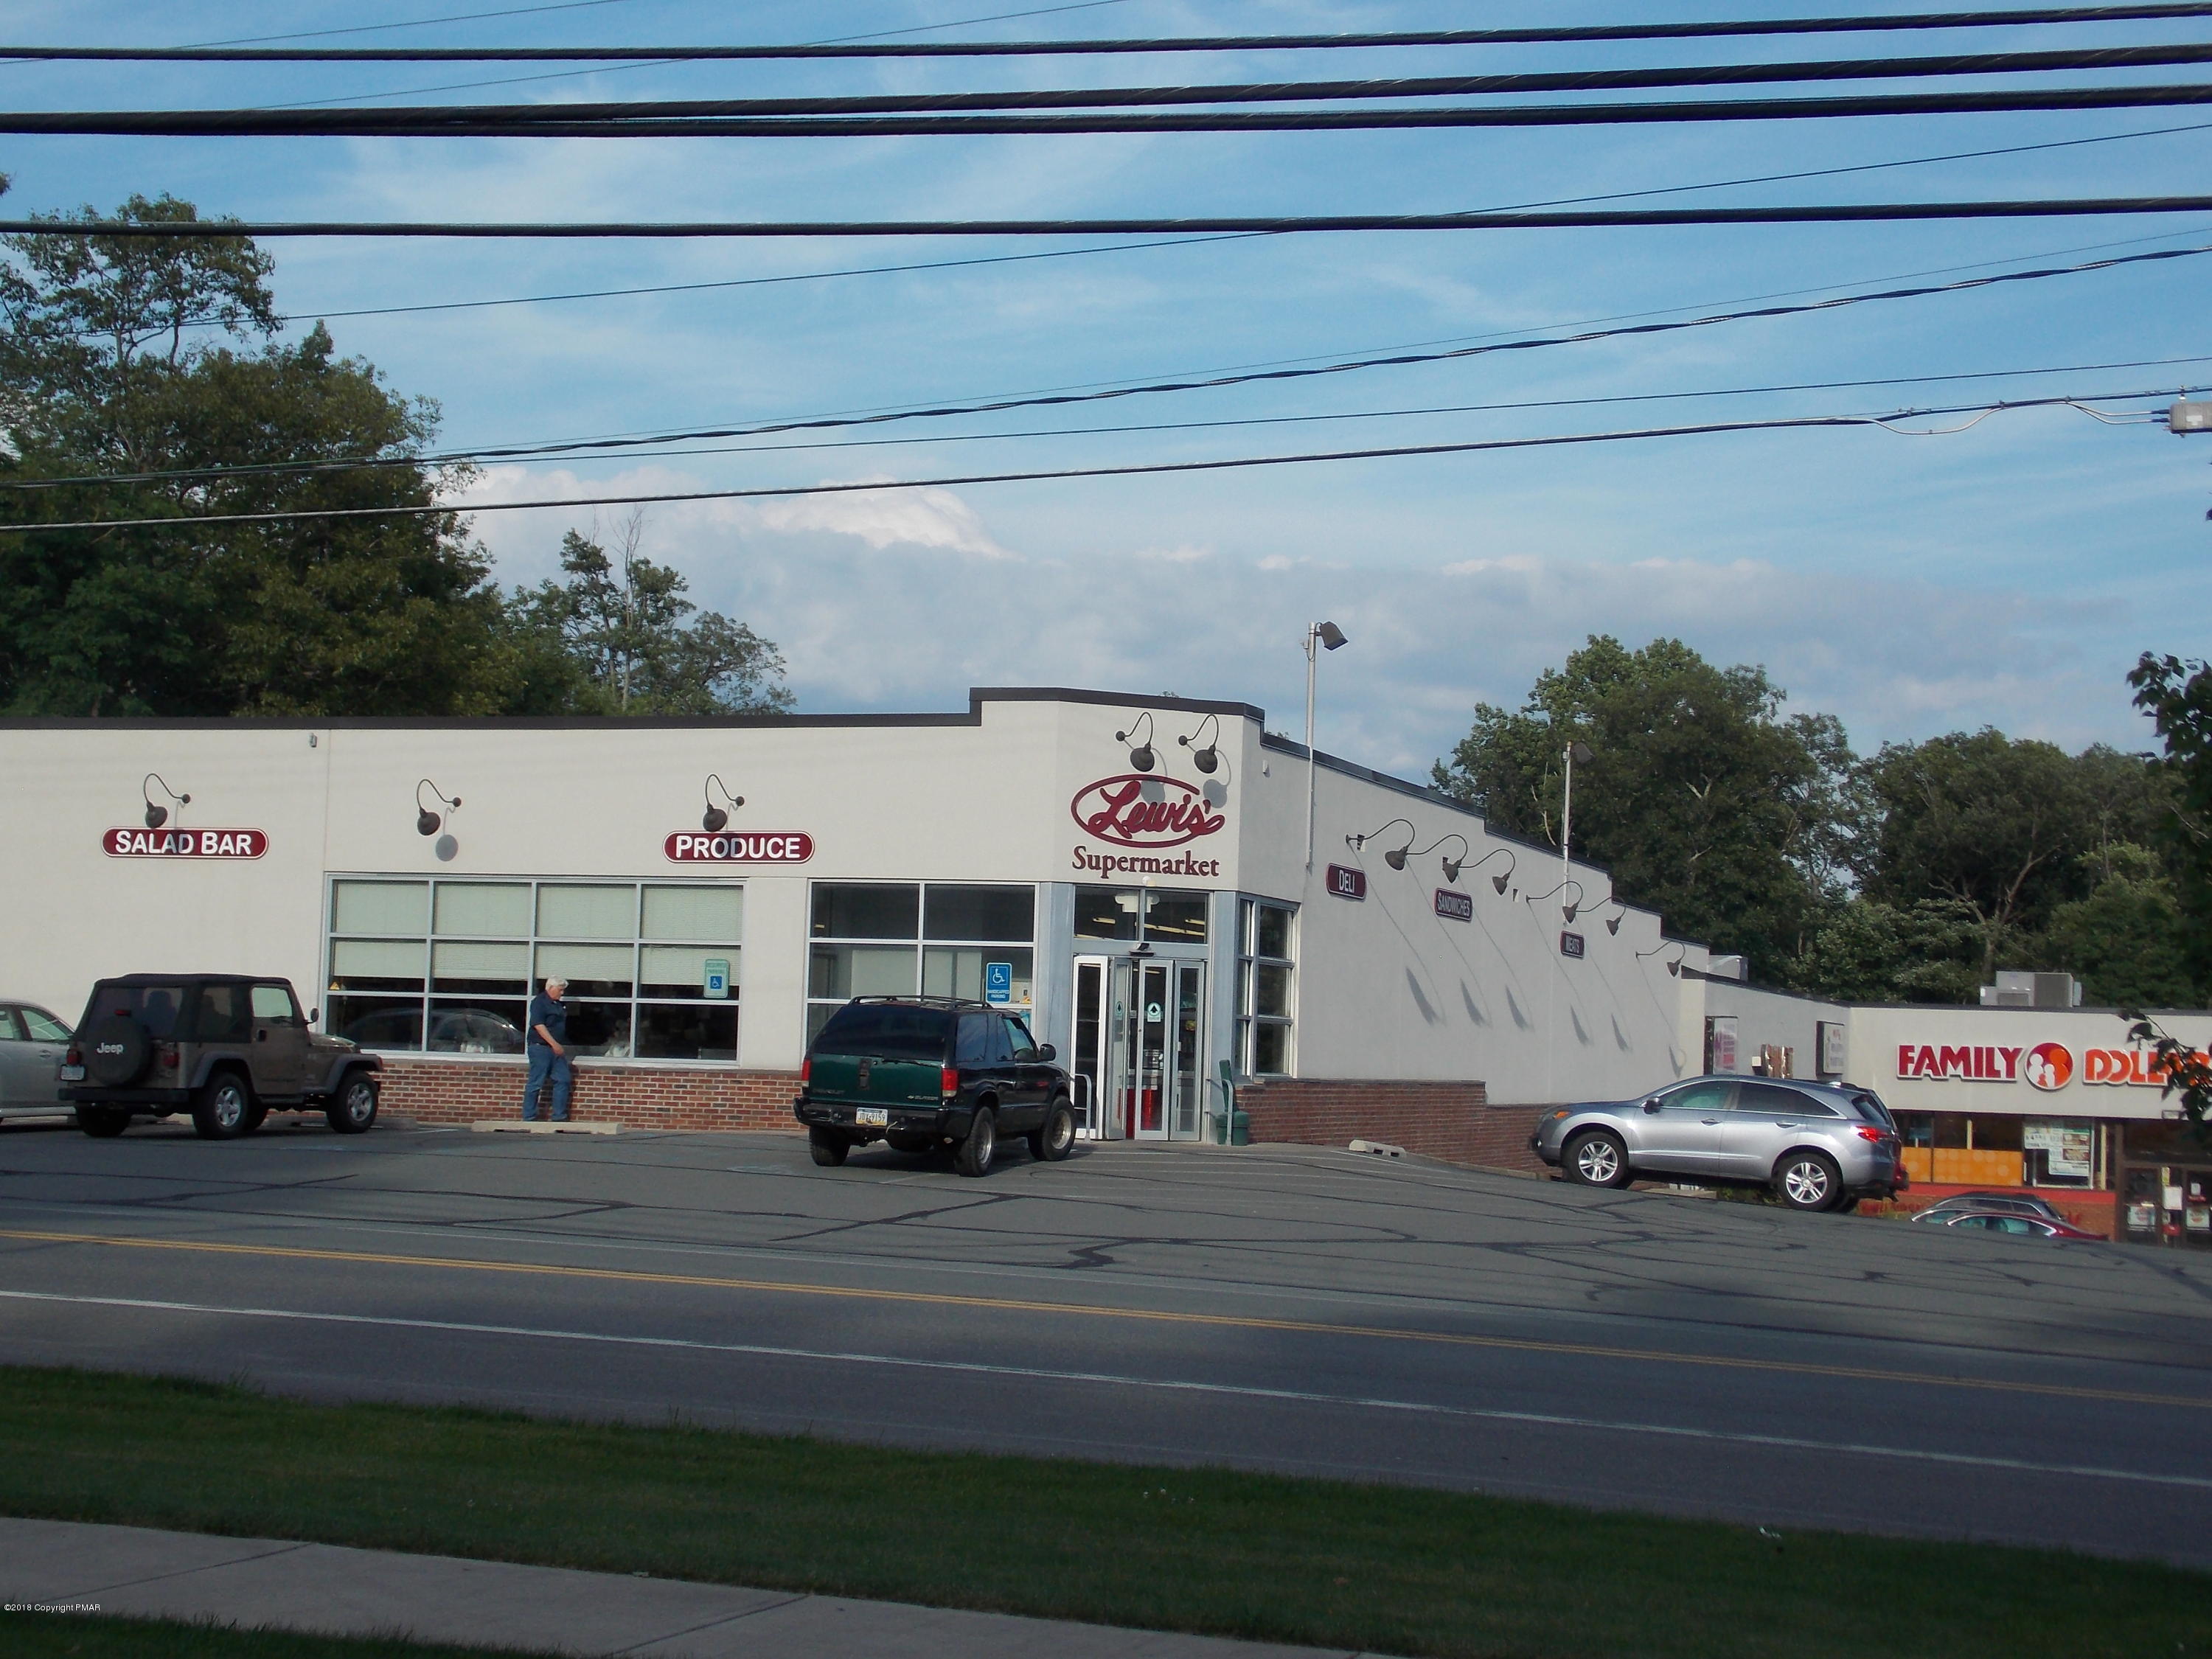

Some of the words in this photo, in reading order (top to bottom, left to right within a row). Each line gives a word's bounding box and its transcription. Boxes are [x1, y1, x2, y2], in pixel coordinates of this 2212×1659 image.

[115, 830, 195, 854] SALAD
[201, 831, 252, 855] BAR
[675, 835, 801, 858] PRODUCE
[1072, 846, 1220, 879] Supermarket
[1338, 869, 1355, 894] DELI
[1437, 891, 1470, 917] SANDWICHES
[97, 1042, 124, 1055] Jeep
[1898, 1045, 2025, 1079] FAMILY
[2084, 1048, 2212, 1085] DOLL
